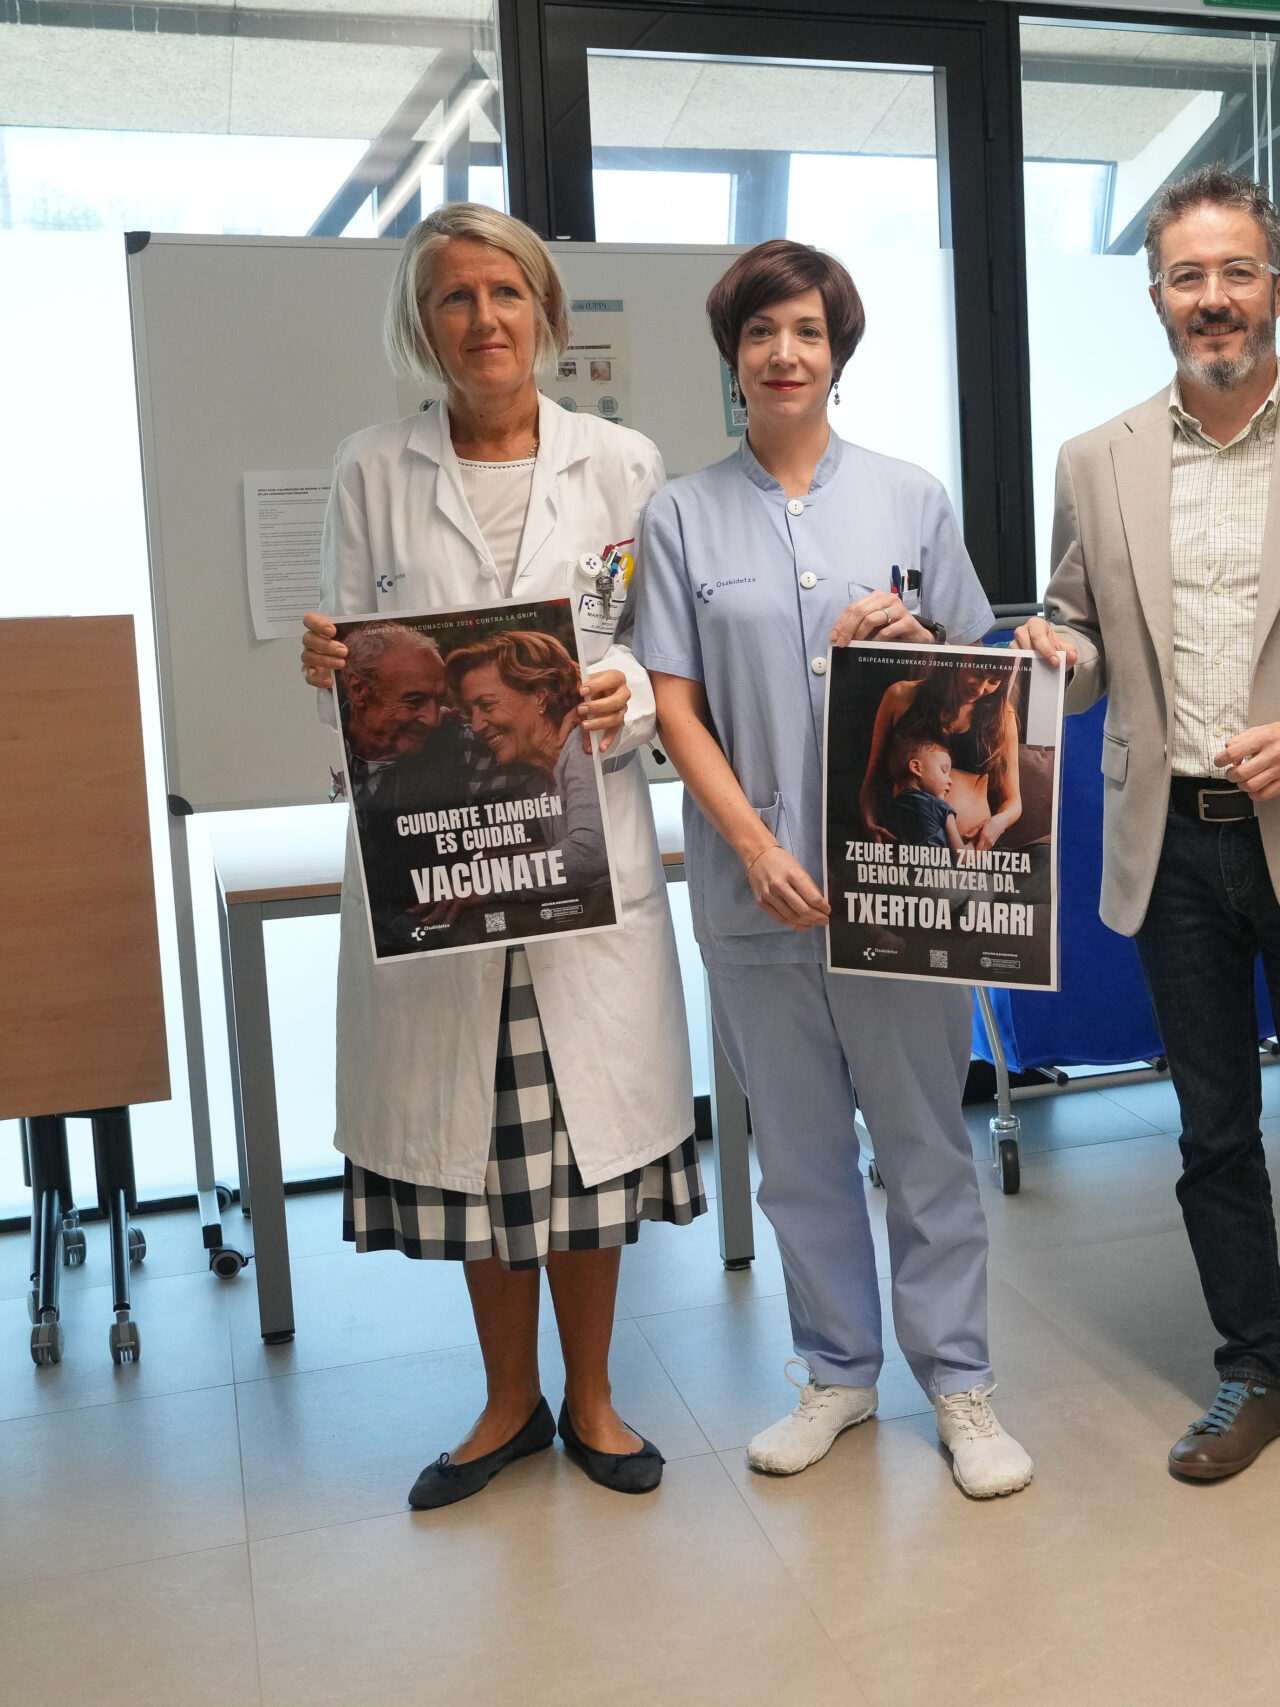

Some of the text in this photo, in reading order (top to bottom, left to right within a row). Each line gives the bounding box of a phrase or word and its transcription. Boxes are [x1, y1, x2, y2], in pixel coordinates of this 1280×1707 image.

[475, 615, 504, 625] CONTRA
[517, 611, 538, 620] GRIPE
[396, 792, 563, 837] CUIDARTE TAMBIÉN
[435, 825, 532, 855] ES CUIDAR.
[845, 841, 1031, 873] ZEURE BURUA ZAINTZEA
[410, 849, 568, 904] VACÚNATE
[857, 864, 1020, 894] DENOK ZAINTZEA DA.
[844, 892, 1034, 937] TXERTOA JARRI
